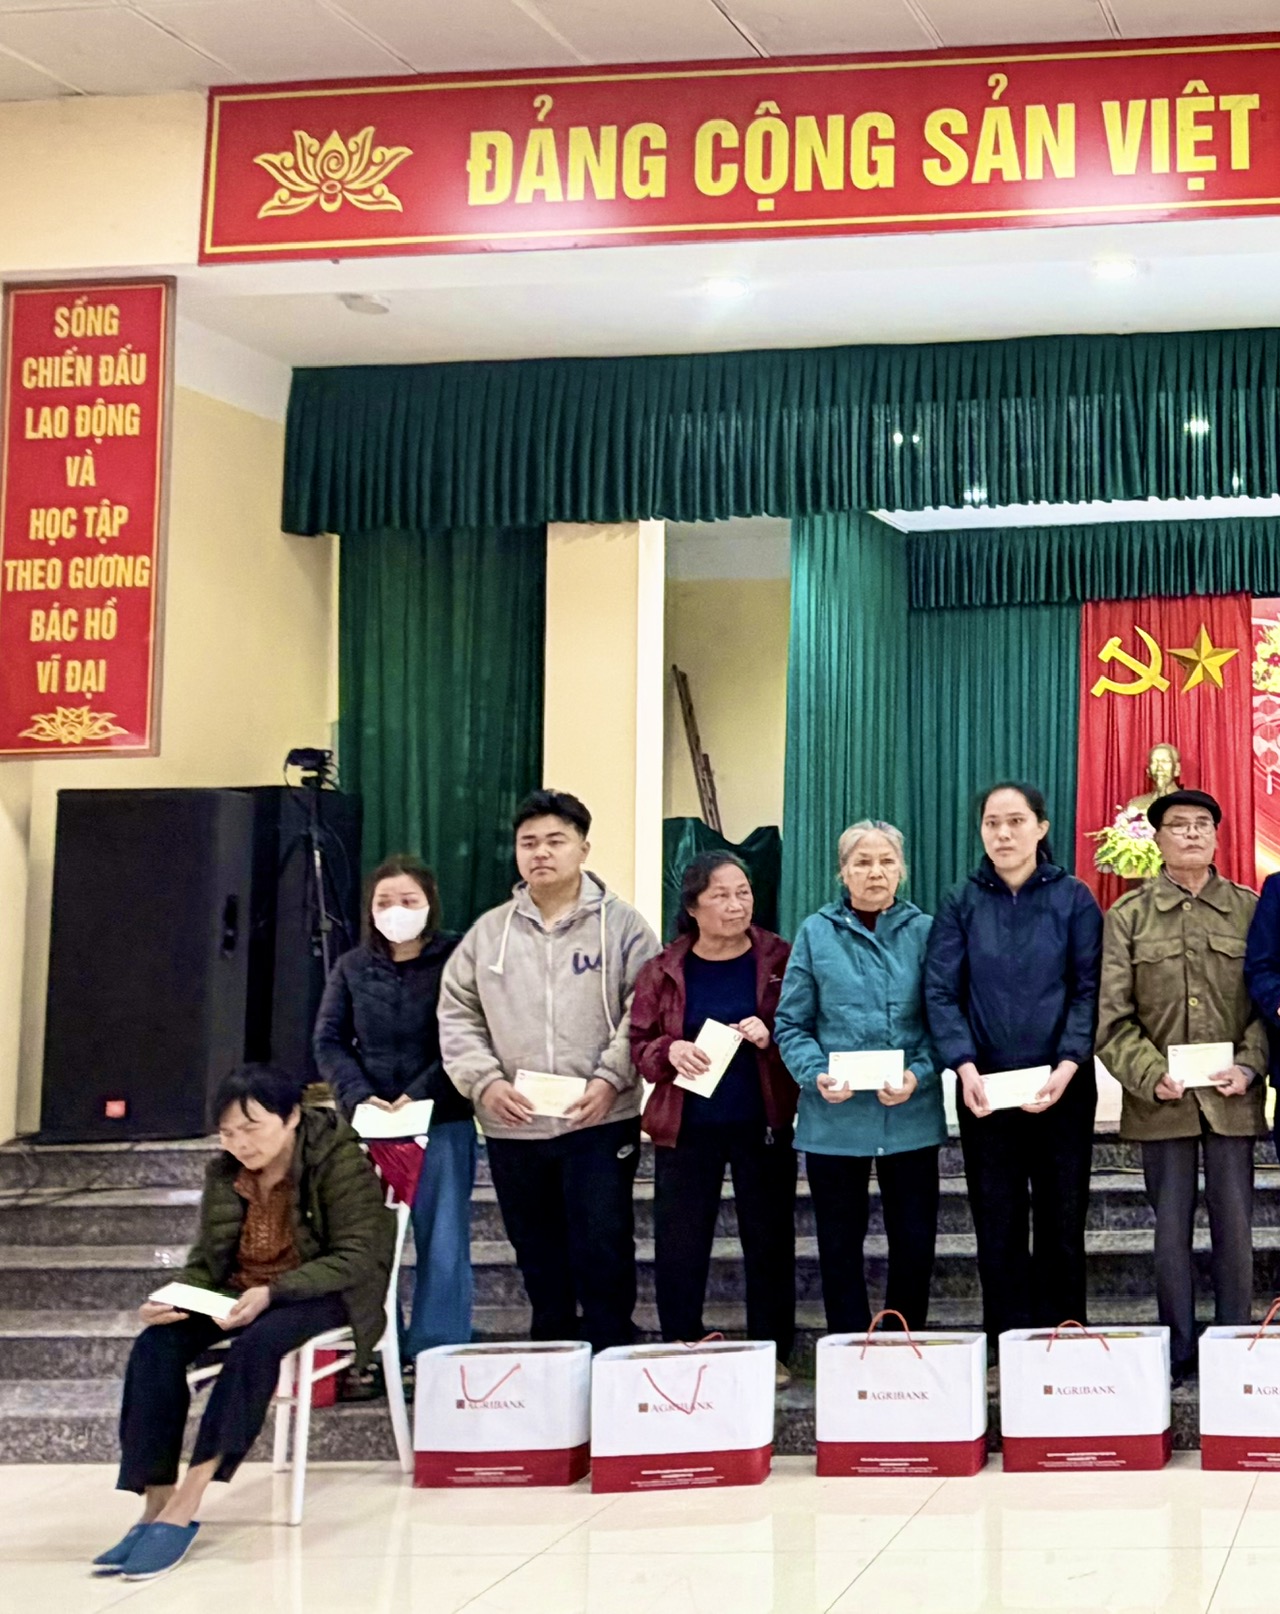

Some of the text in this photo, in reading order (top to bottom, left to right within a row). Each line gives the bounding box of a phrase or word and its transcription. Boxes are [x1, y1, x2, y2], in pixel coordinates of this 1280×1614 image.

[466, 93, 668, 206] ĐẢNG
[693, 100, 896, 211] CỘNG
[921, 73, 1077, 187] SẢN
[1101, 79, 1260, 191] VIỆT
[53, 294, 120, 339] SỐNG
[22, 343, 148, 389] CHIẾN ĐẤU
[25, 398, 141, 445] LAO ĐỘNG
[65, 448, 97, 488] VÀ
[29, 498, 129, 547] HỌC TẬP
[4, 552, 151, 592] THEO GƯƠNG
[30, 596, 119, 643] BÁC HỒ
[36, 653, 107, 700] VĨ ĐẠI
[869, 1389, 931, 1401] AGRIBANK
[1054, 1384, 1117, 1396] AGRIBANK
